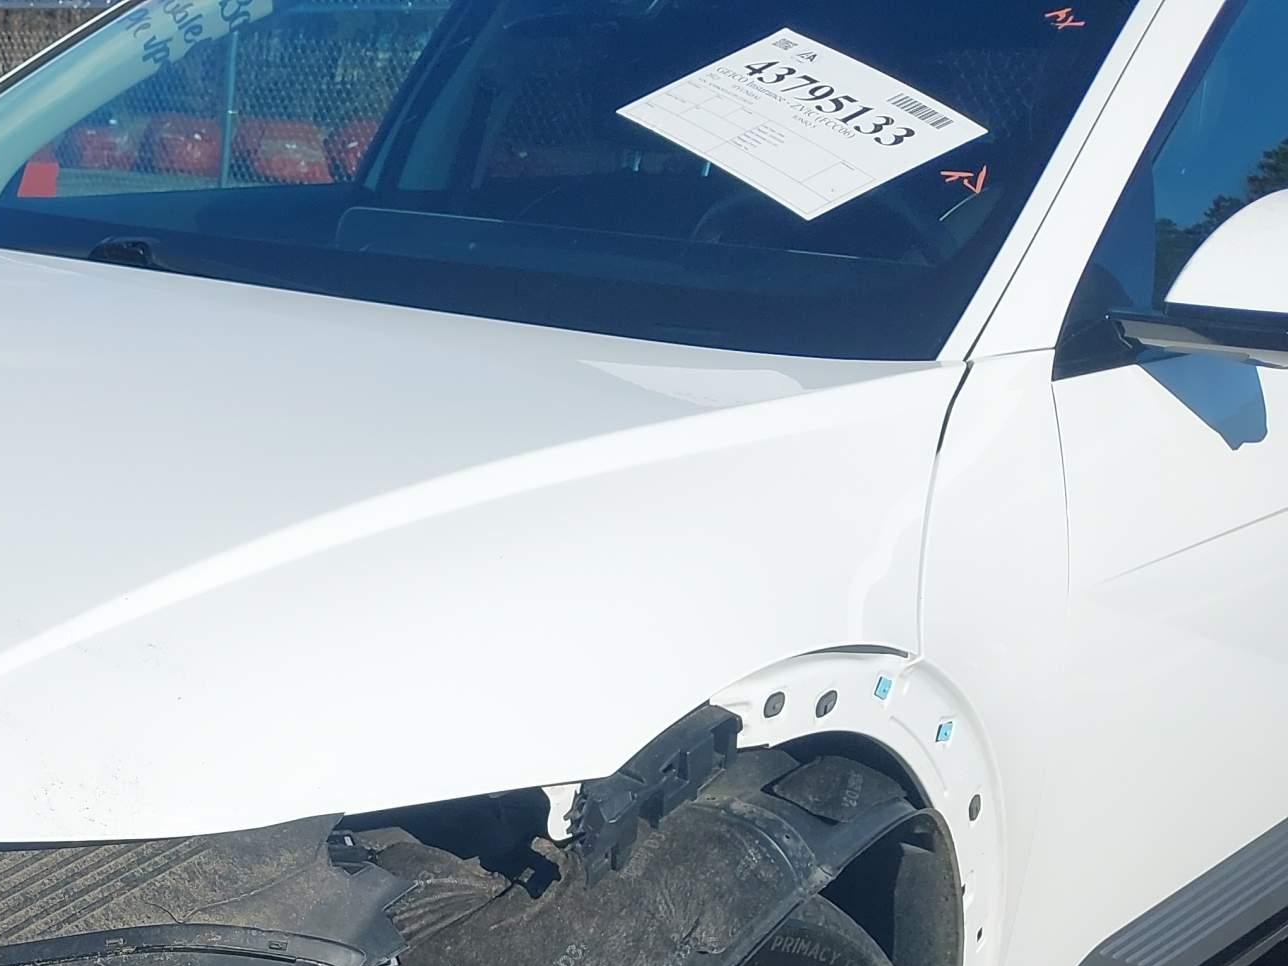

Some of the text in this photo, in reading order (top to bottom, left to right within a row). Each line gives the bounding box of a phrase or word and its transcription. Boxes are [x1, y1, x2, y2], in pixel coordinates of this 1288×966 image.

[743, 60, 916, 147] 43795133
[746, 78, 790, 104] Insurance
[770, 935, 841, 965] PRIMACY
